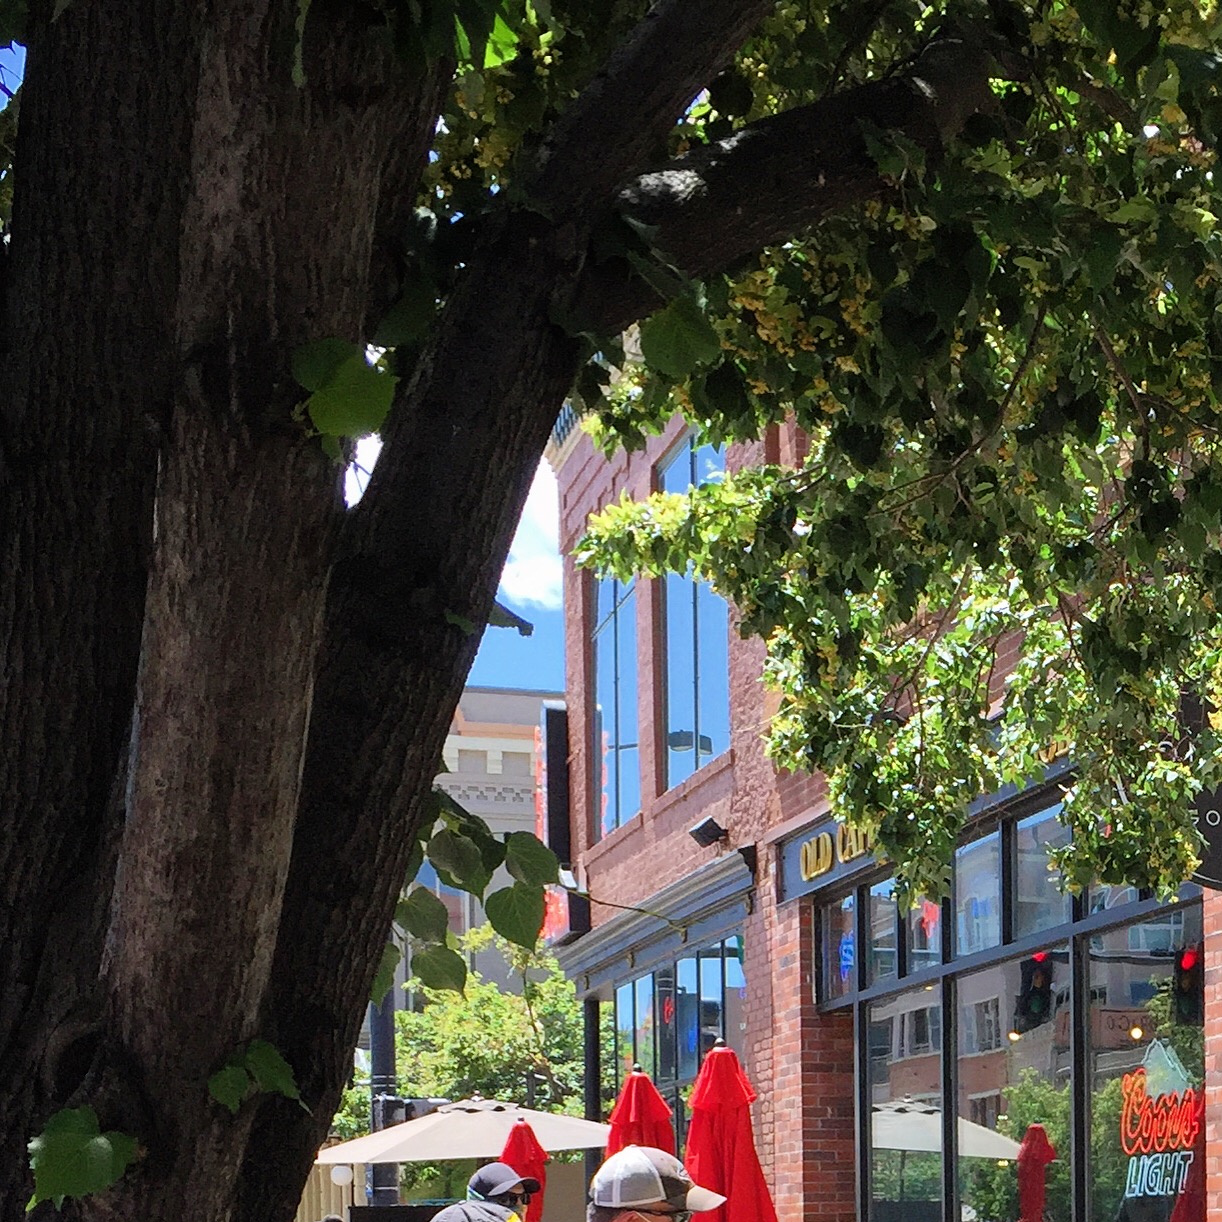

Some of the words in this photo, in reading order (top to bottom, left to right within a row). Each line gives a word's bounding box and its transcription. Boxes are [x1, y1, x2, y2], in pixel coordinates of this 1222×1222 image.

[800, 831, 833, 881] OLD
[1120, 1067, 1200, 1156] Coors
[1125, 1150, 1195, 1199] LIGHT
